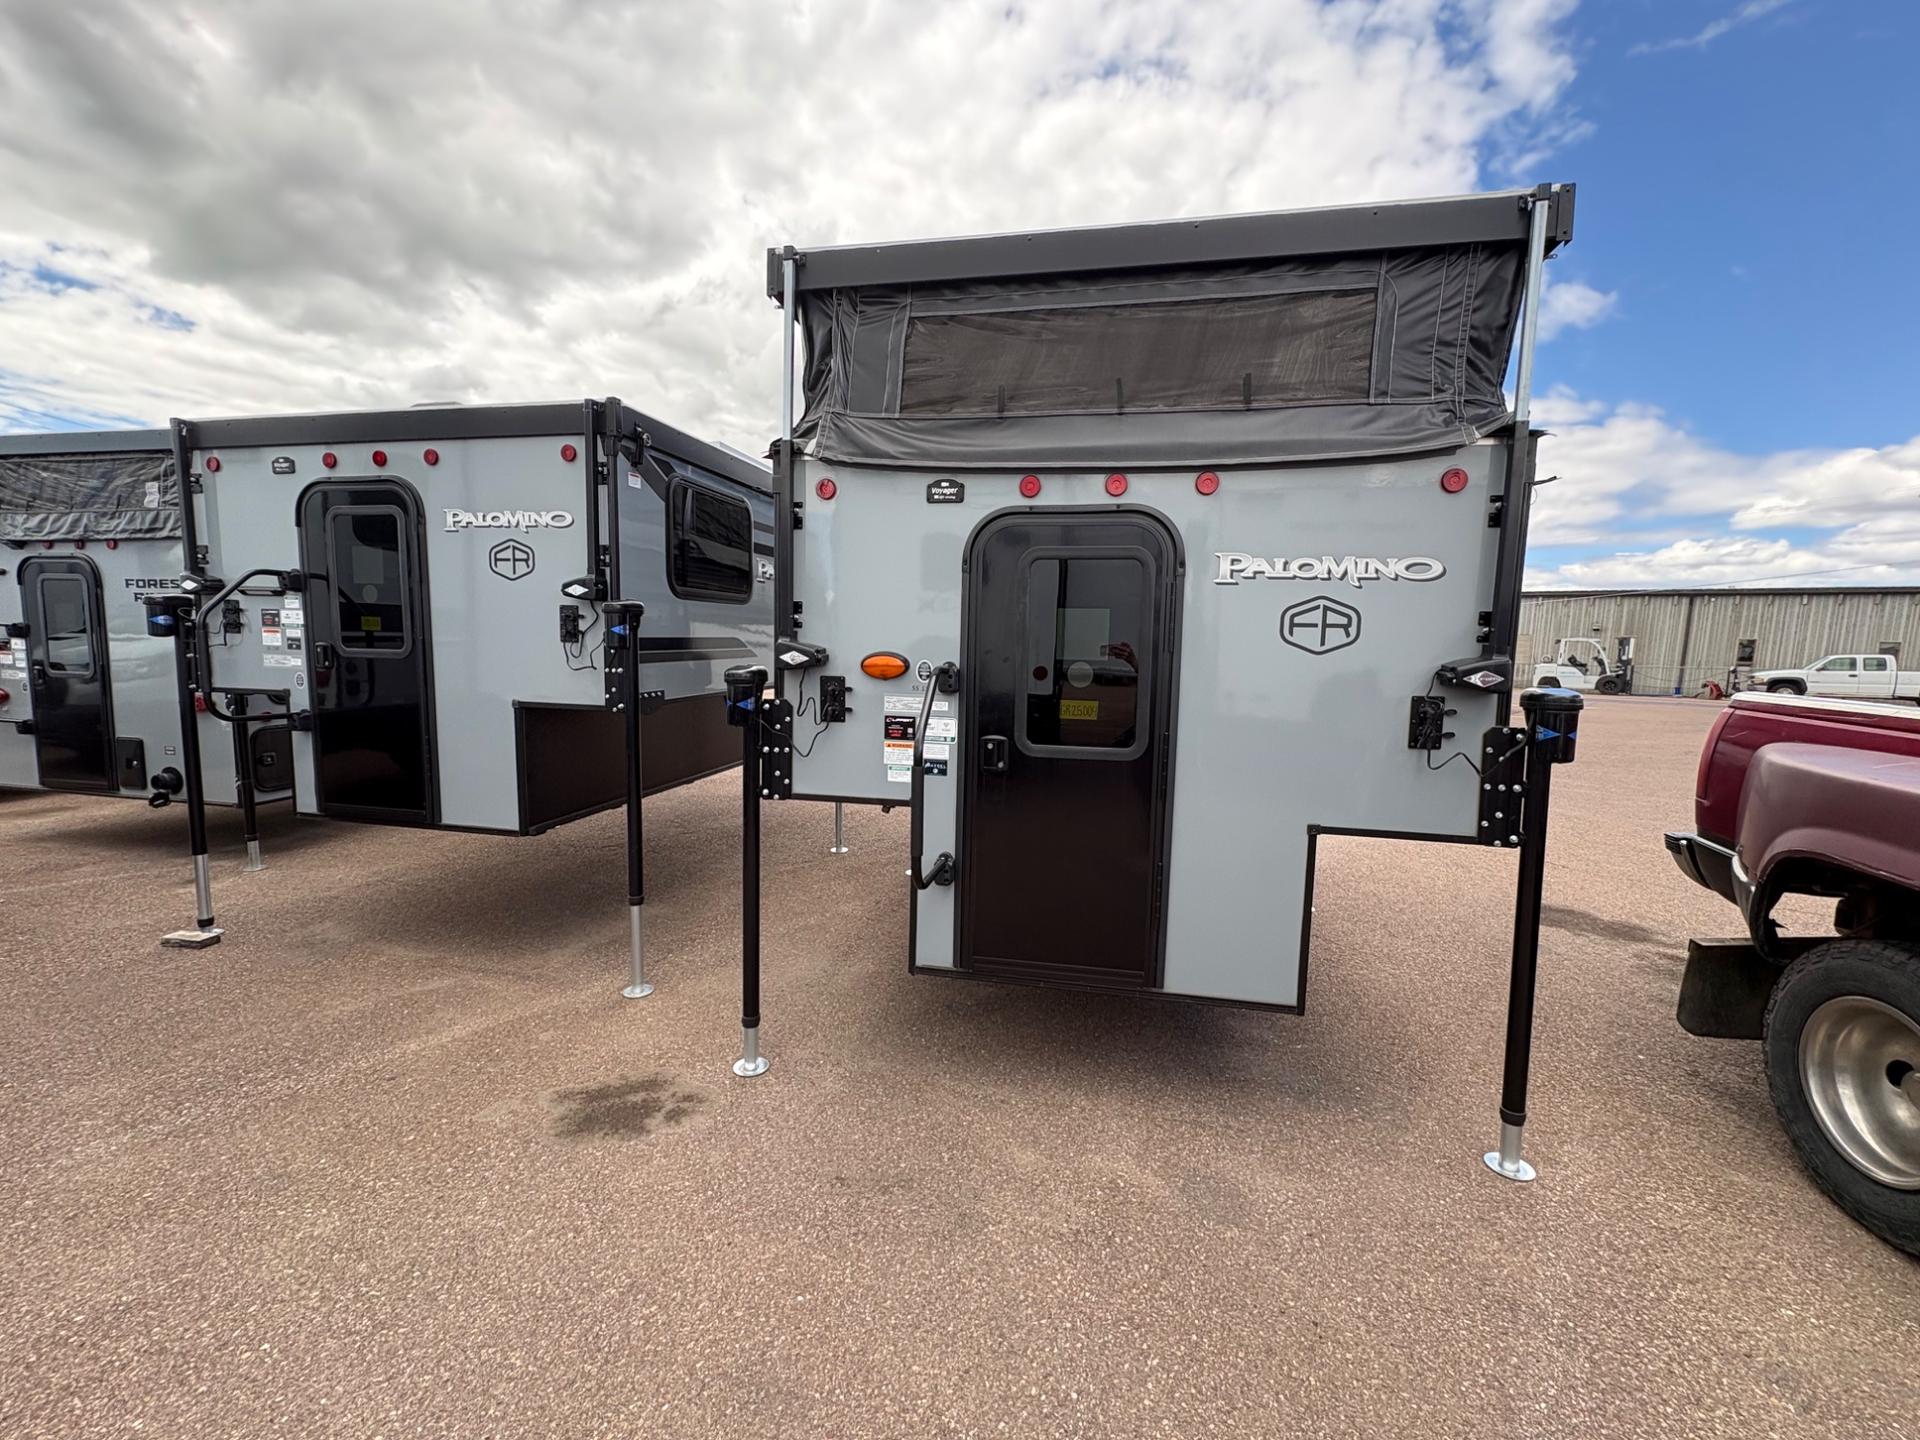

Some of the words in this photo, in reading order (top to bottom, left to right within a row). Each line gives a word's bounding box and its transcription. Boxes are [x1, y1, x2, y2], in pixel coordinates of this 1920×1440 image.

[931, 487, 959, 495] Voyager
[443, 508, 574, 534] PALOMINO
[1213, 552, 1447, 589] PALOMINO
[124, 578, 181, 589] FORES
